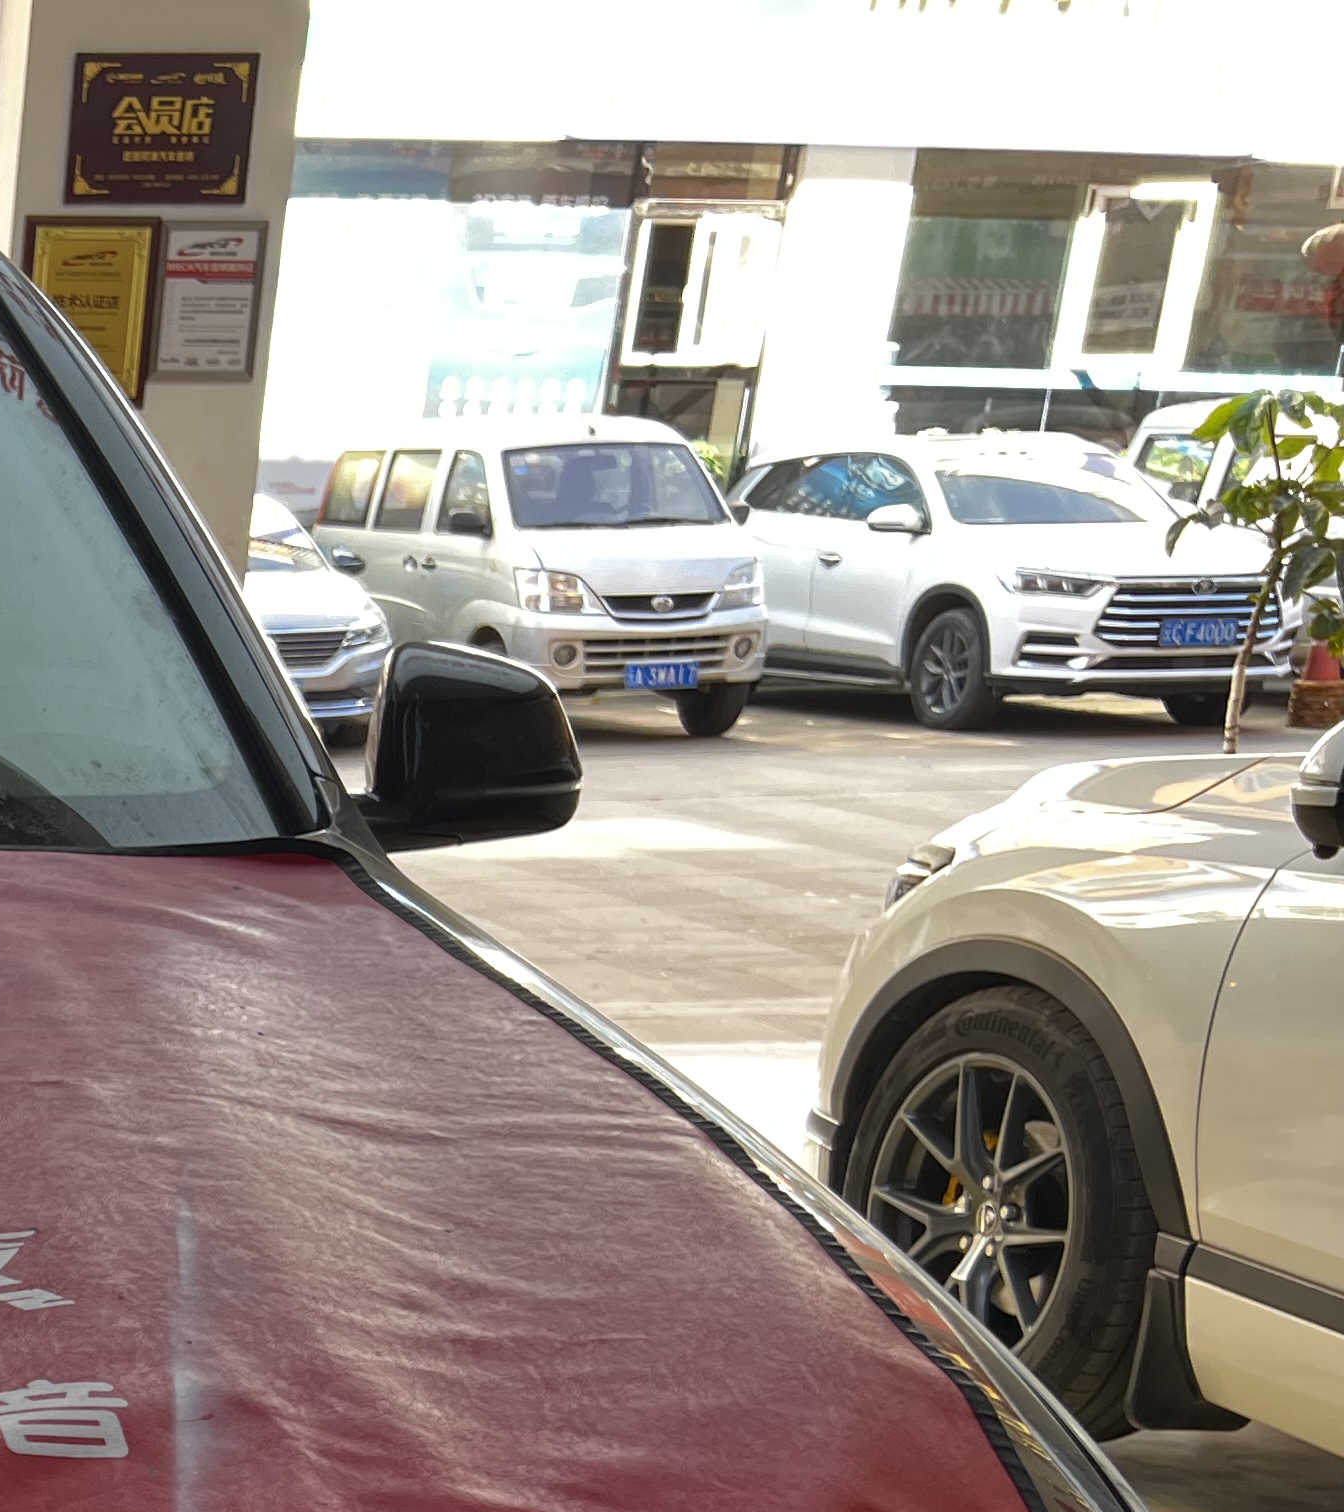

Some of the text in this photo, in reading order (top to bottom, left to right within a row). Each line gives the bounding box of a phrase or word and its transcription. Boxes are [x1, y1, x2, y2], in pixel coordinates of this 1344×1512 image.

[111, 95, 216, 136] 会员店
[954, 1007, 1056, 1061] Continental
